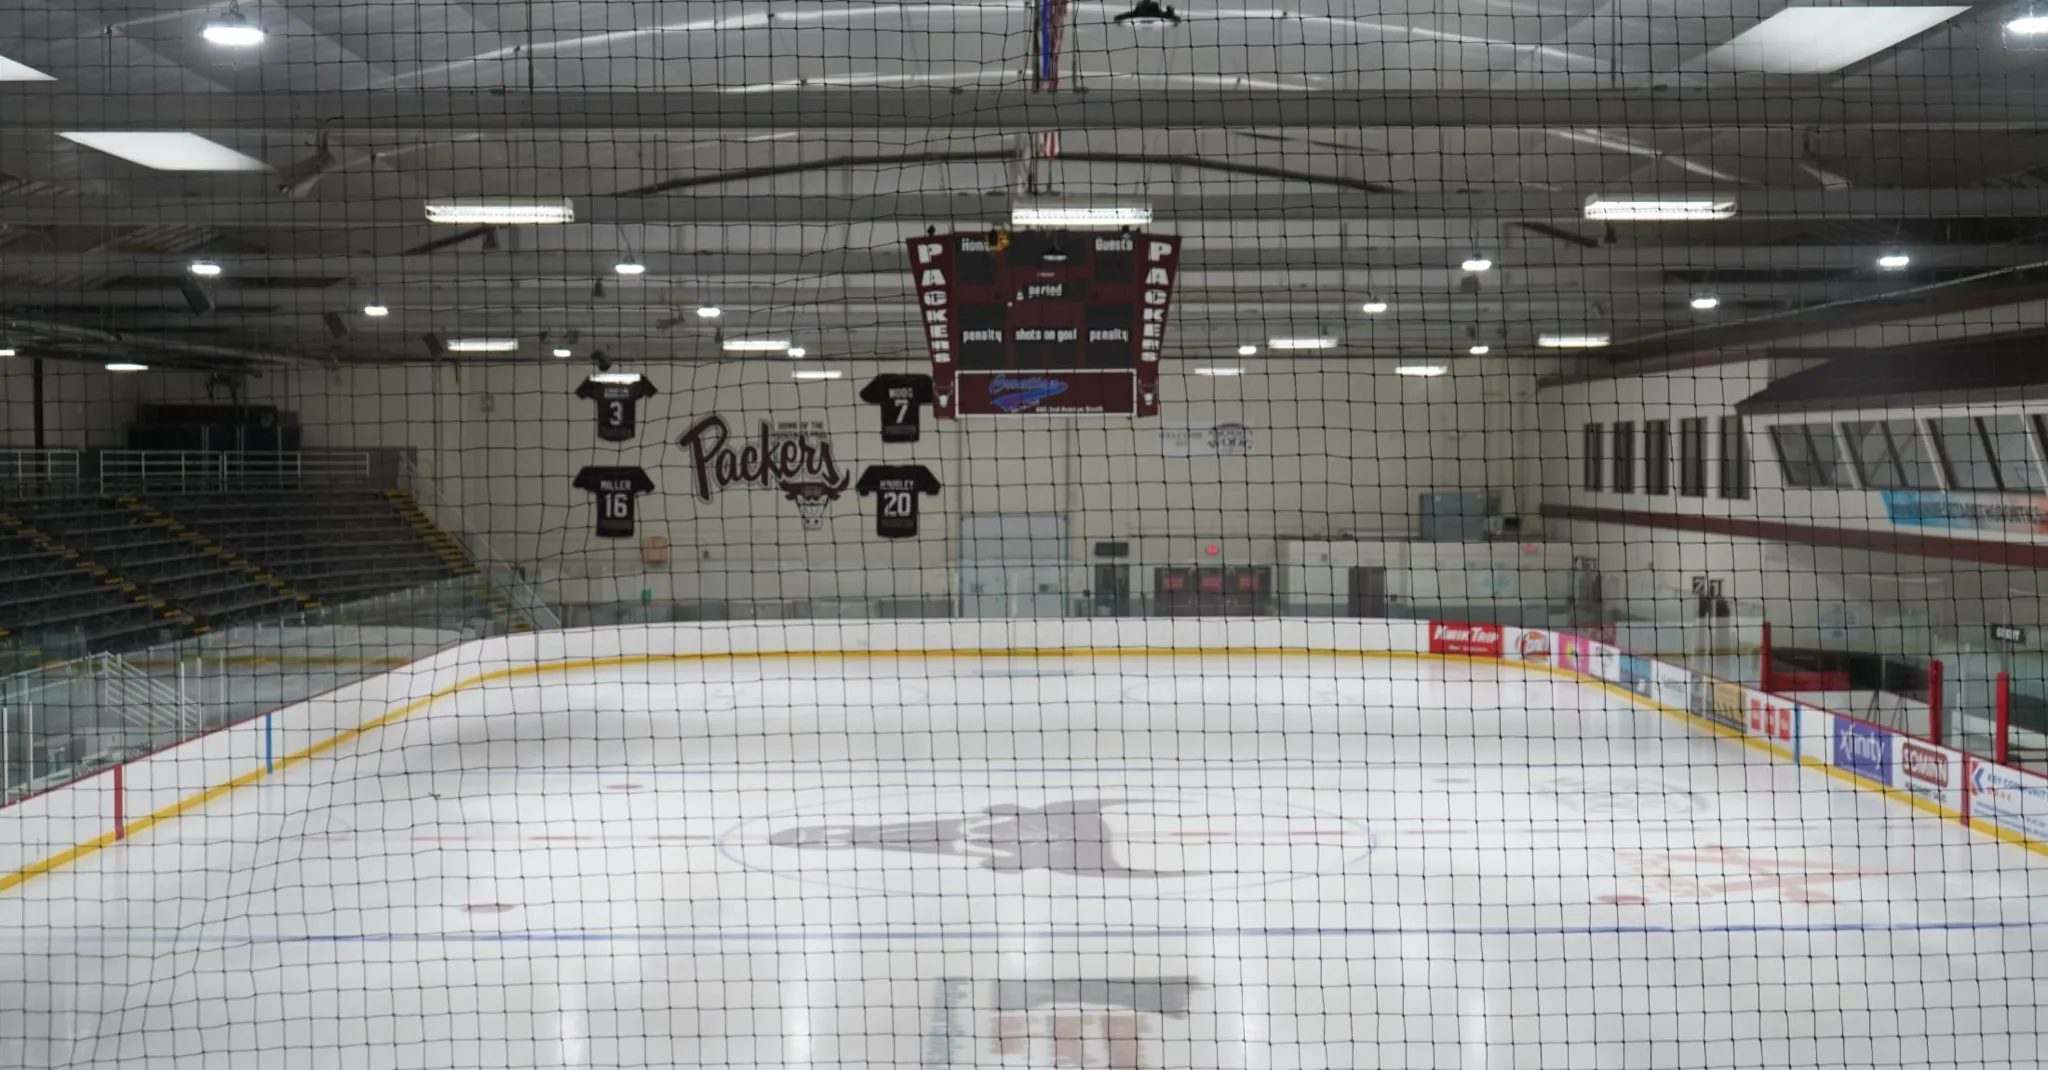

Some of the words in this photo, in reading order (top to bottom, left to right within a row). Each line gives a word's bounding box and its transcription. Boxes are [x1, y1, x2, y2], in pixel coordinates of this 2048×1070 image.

[917, 243, 951, 363] PACKERS
[1028, 283, 1062, 299] period
[1141, 241, 1172, 362] PACKERS
[963, 329, 1002, 343] penalty
[1015, 328, 1041, 340] shots
[1043, 330, 1056, 340] on
[1057, 328, 1077, 343] goal
[1089, 329, 1129, 343] penalty
[610, 401, 622, 426] 3
[894, 400, 908, 424] 7
[678, 414, 842, 502] Packers
[604, 492, 628, 518] 16
[884, 492, 911, 517] 20
[1433, 625, 1470, 642] KWIK
[1470, 627, 1499, 644] TRIP
[1840, 723, 1885, 771] xfinity
